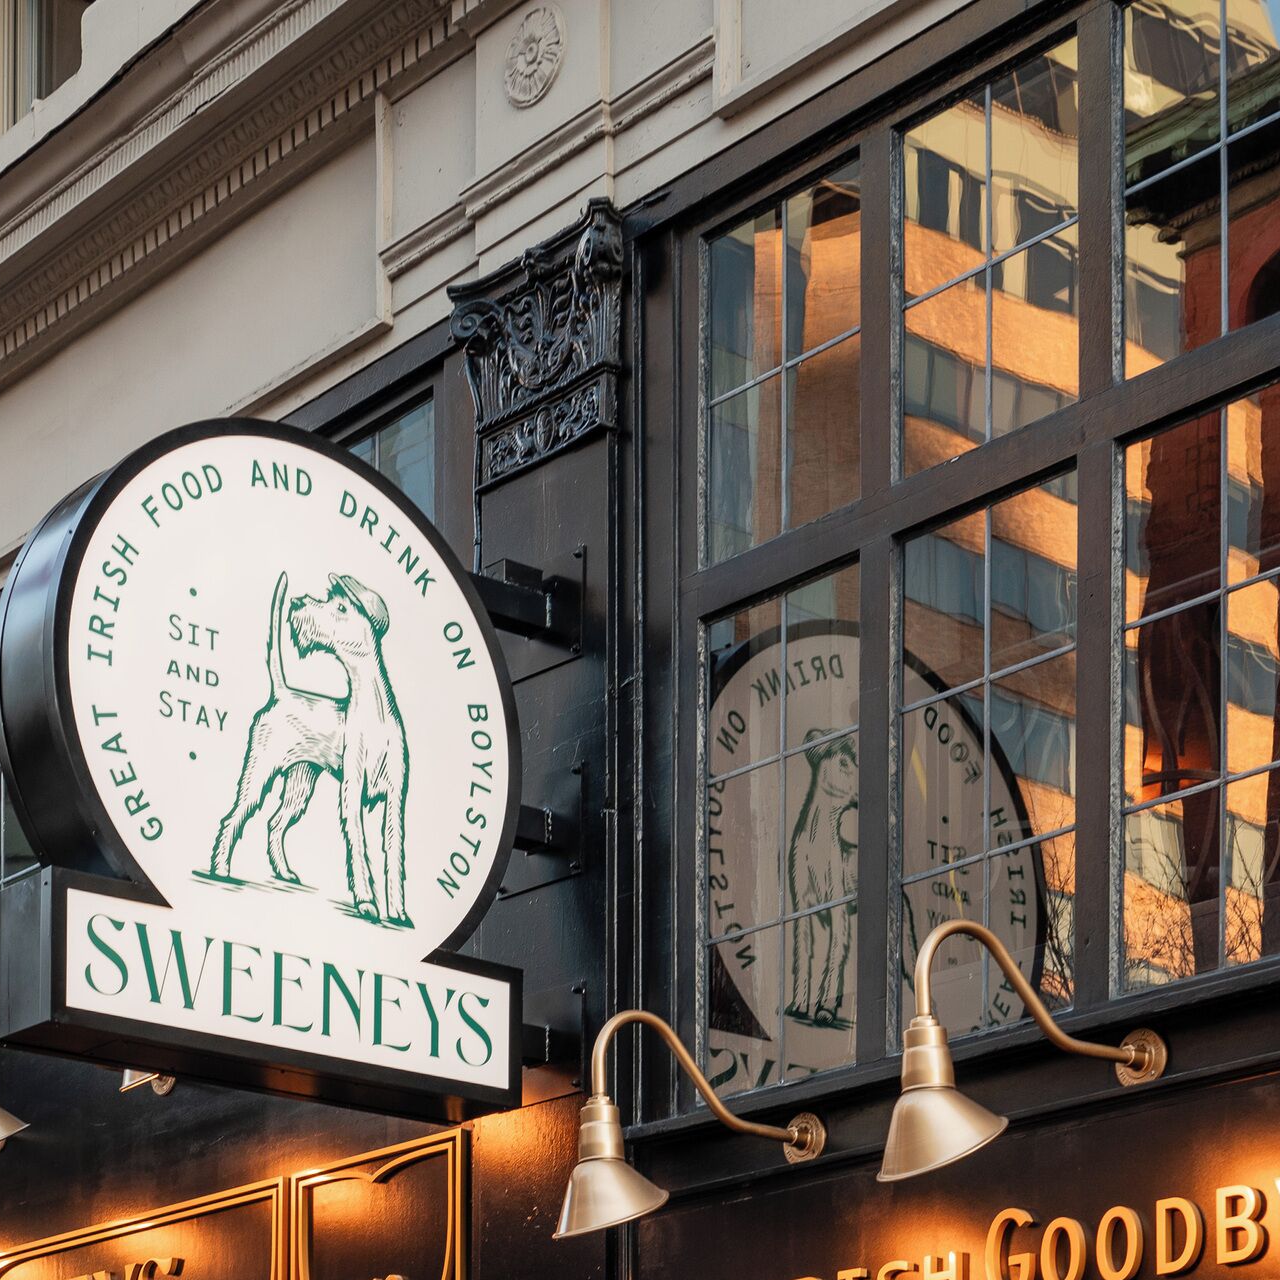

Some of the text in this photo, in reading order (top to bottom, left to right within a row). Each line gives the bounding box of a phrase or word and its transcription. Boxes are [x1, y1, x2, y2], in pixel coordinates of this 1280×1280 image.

[168, 614, 220, 651] SIT
[87, 460, 492, 900] GREAT IRISH FOOD AND DRINK ON BOYLSTON
[166, 658, 220, 687] AND
[159, 690, 228, 732] STAY
